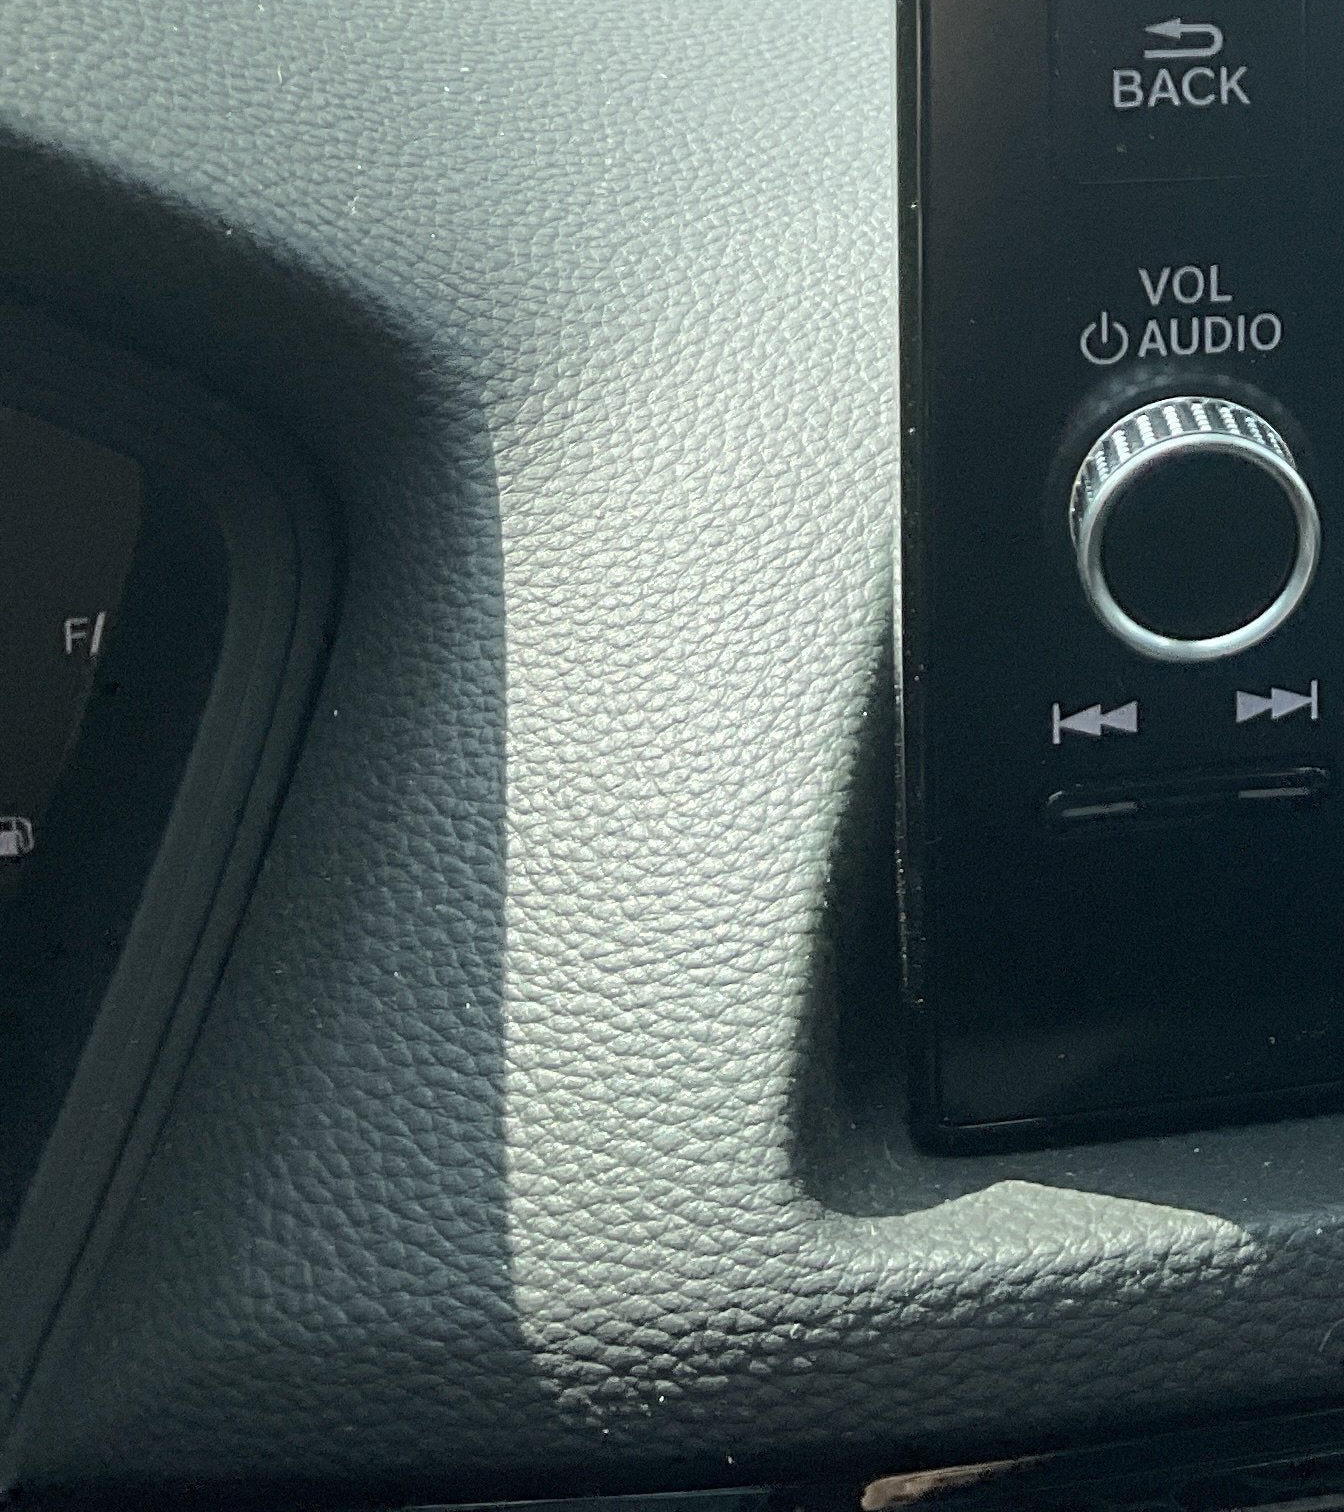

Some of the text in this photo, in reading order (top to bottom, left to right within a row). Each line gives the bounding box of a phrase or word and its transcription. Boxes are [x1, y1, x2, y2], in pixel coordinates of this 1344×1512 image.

[1112, 65, 1251, 109] BACK
[1137, 264, 1233, 306] VOL
[1137, 312, 1283, 358] AUDIO
